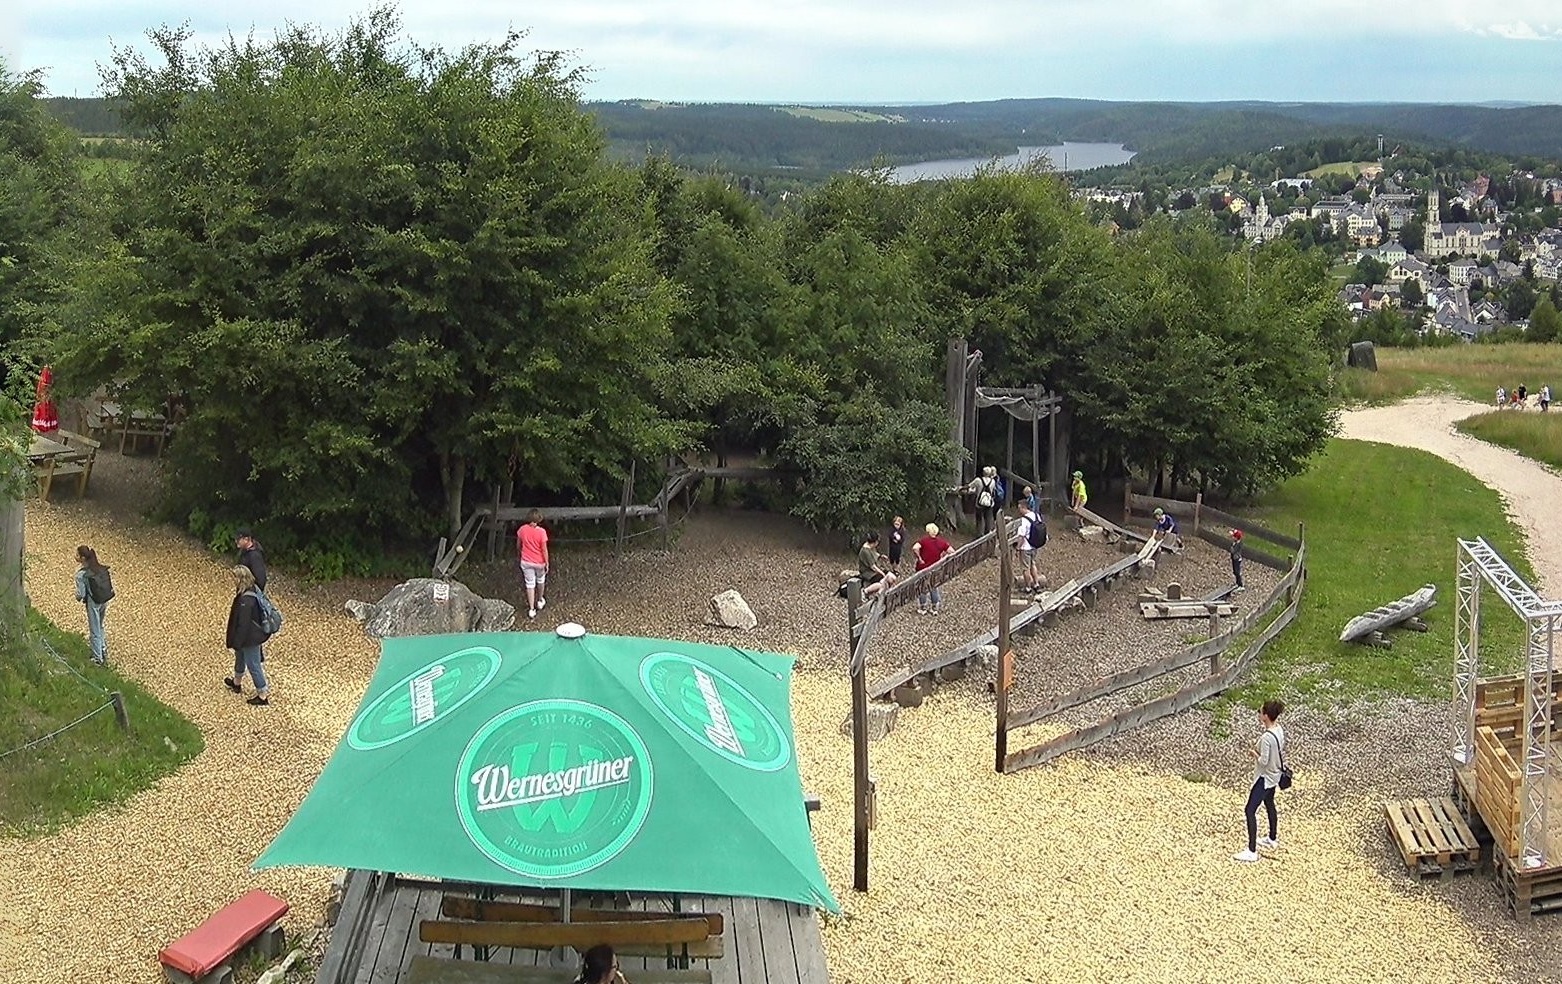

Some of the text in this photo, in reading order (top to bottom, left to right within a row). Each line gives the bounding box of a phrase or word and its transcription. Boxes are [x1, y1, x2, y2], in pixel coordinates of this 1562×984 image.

[531, 714, 592, 728] SEIT 1436
[471, 755, 634, 805] Wernesgrüner
[505, 836, 589, 858] BRAUTRADITION
